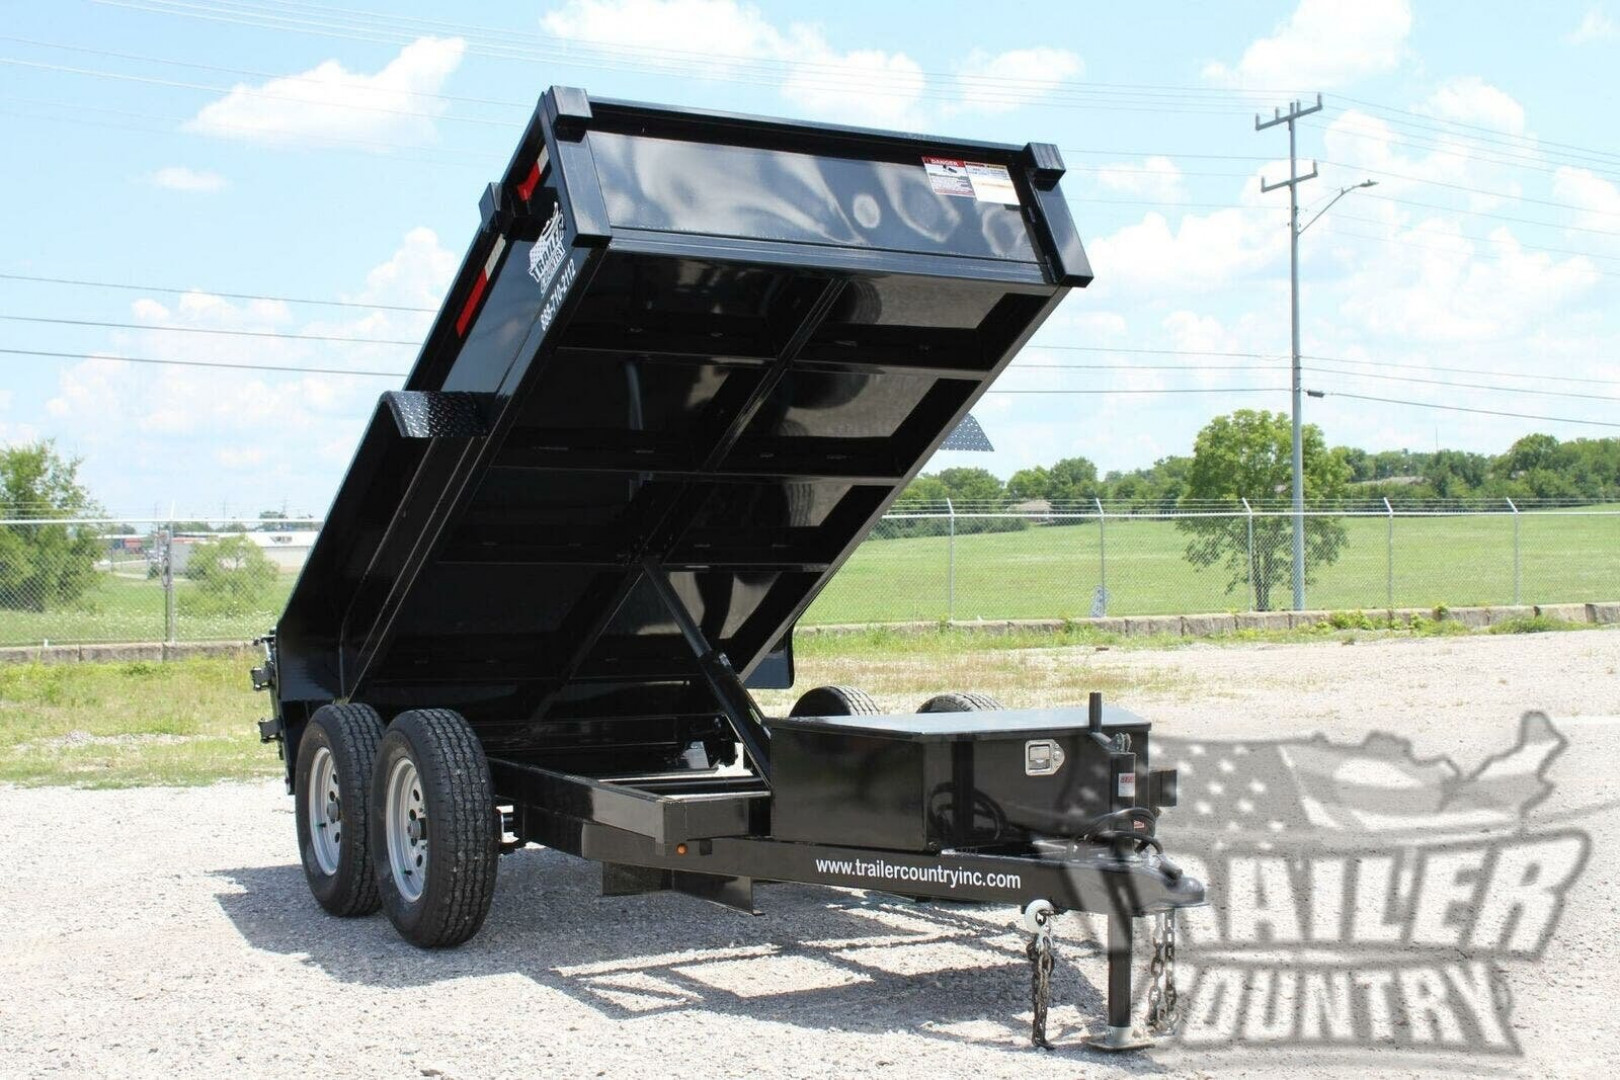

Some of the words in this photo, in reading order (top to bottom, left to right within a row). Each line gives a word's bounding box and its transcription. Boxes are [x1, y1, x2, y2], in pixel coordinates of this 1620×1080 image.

[930, 158, 959, 167] DANGER
[530, 217, 565, 279] TRAILER
[815, 858, 1022, 889] www.trailercountryinc.com
